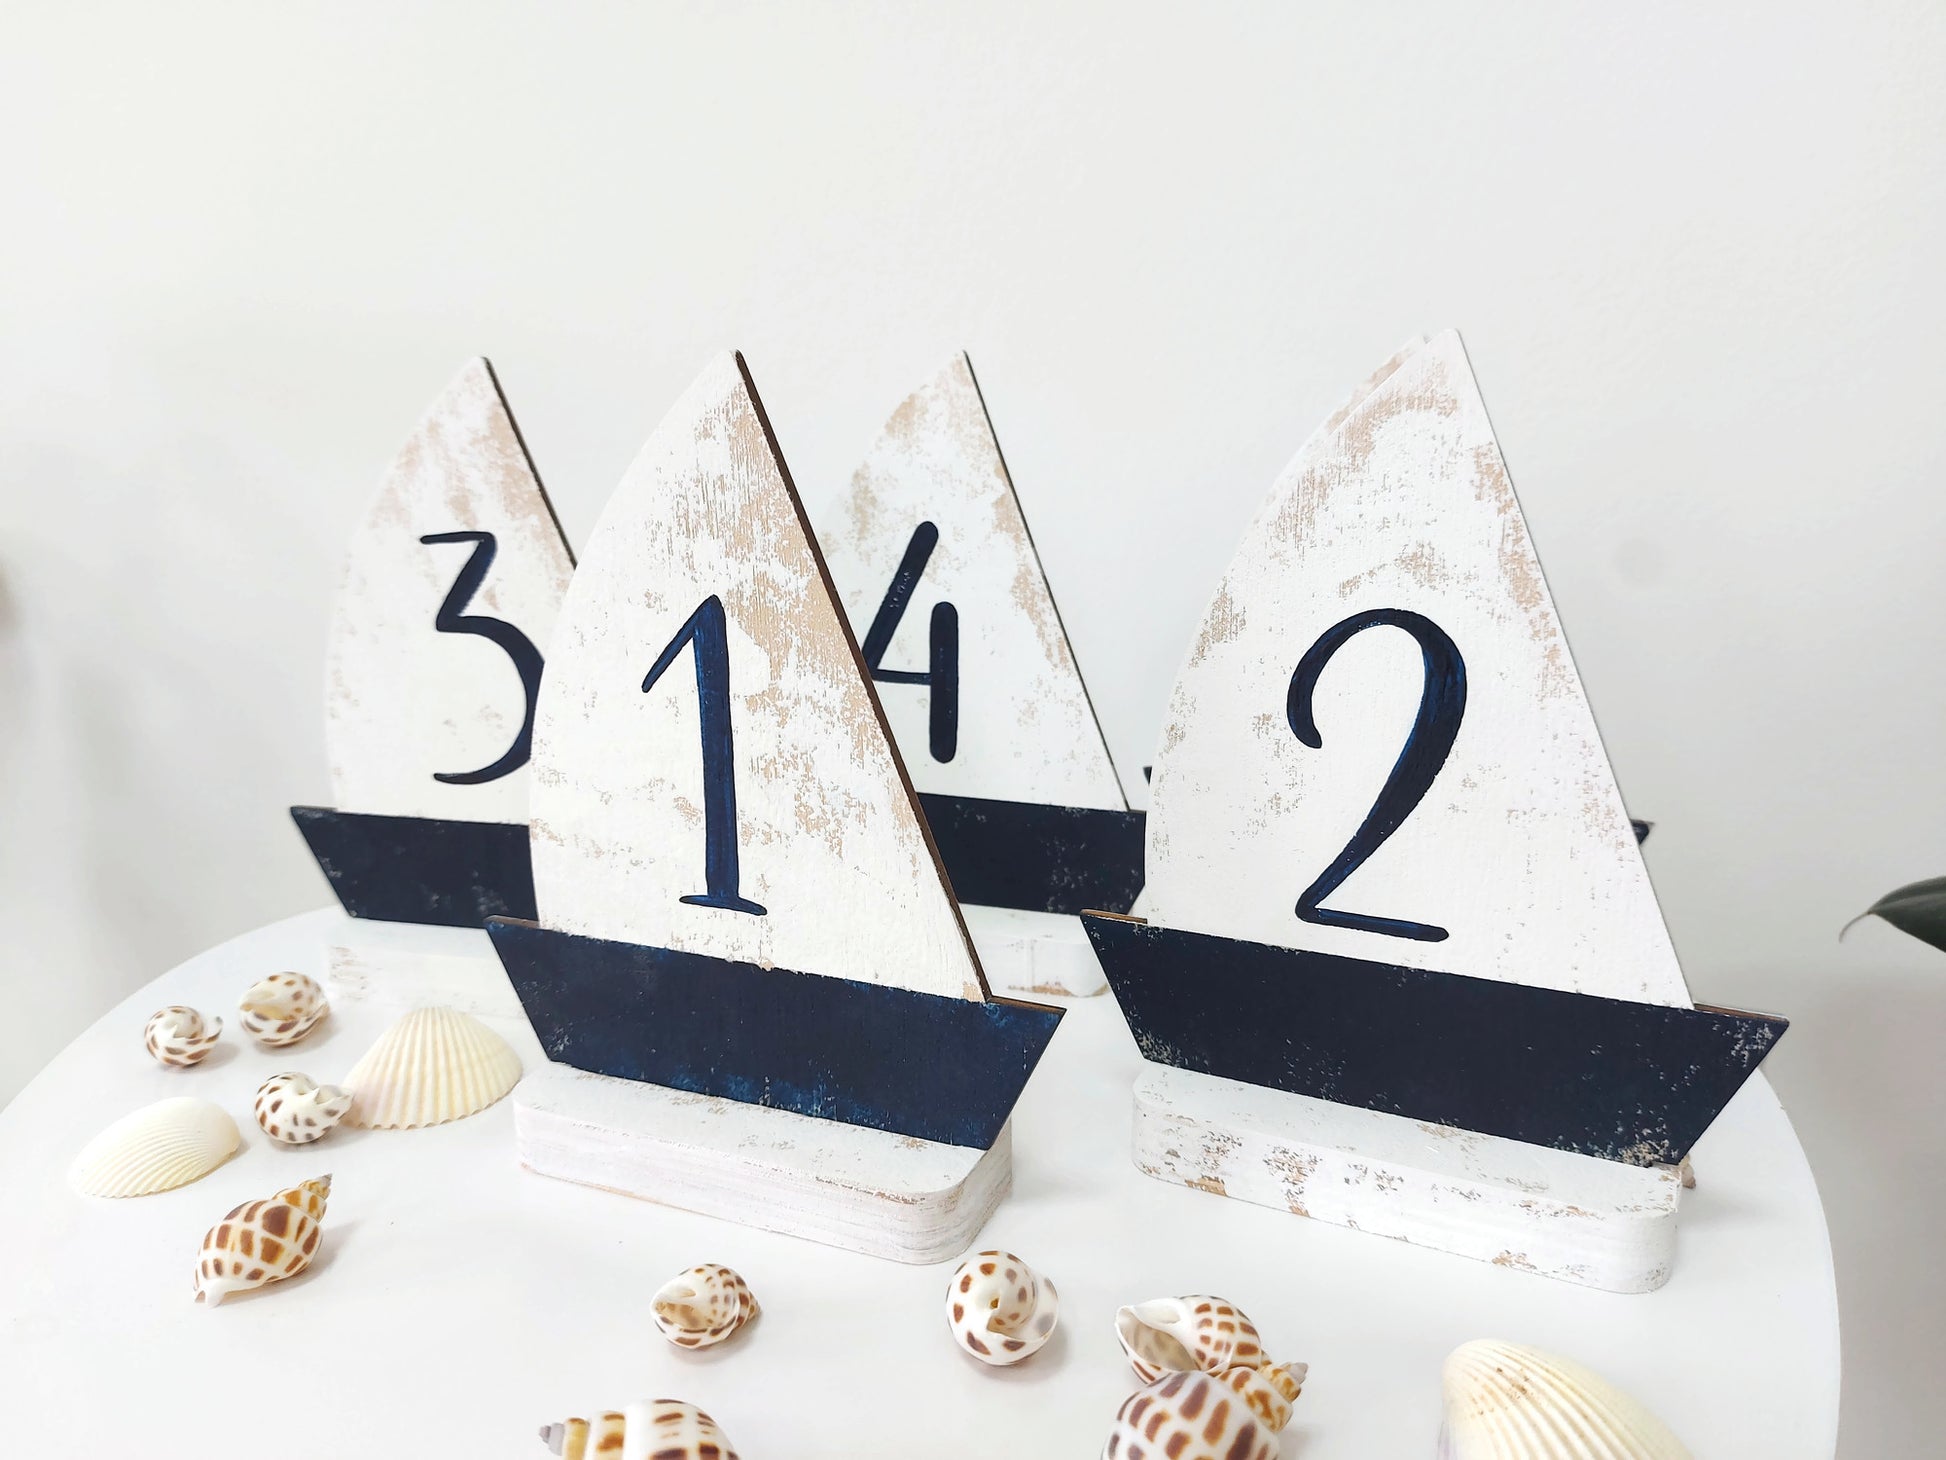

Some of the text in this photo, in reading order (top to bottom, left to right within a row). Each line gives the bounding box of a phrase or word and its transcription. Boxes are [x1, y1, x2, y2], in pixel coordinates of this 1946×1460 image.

[420, 531, 545, 785] 3
[641, 593, 768, 917] 1
[861, 520, 959, 764] 4
[1286, 607, 1468, 943] 2
